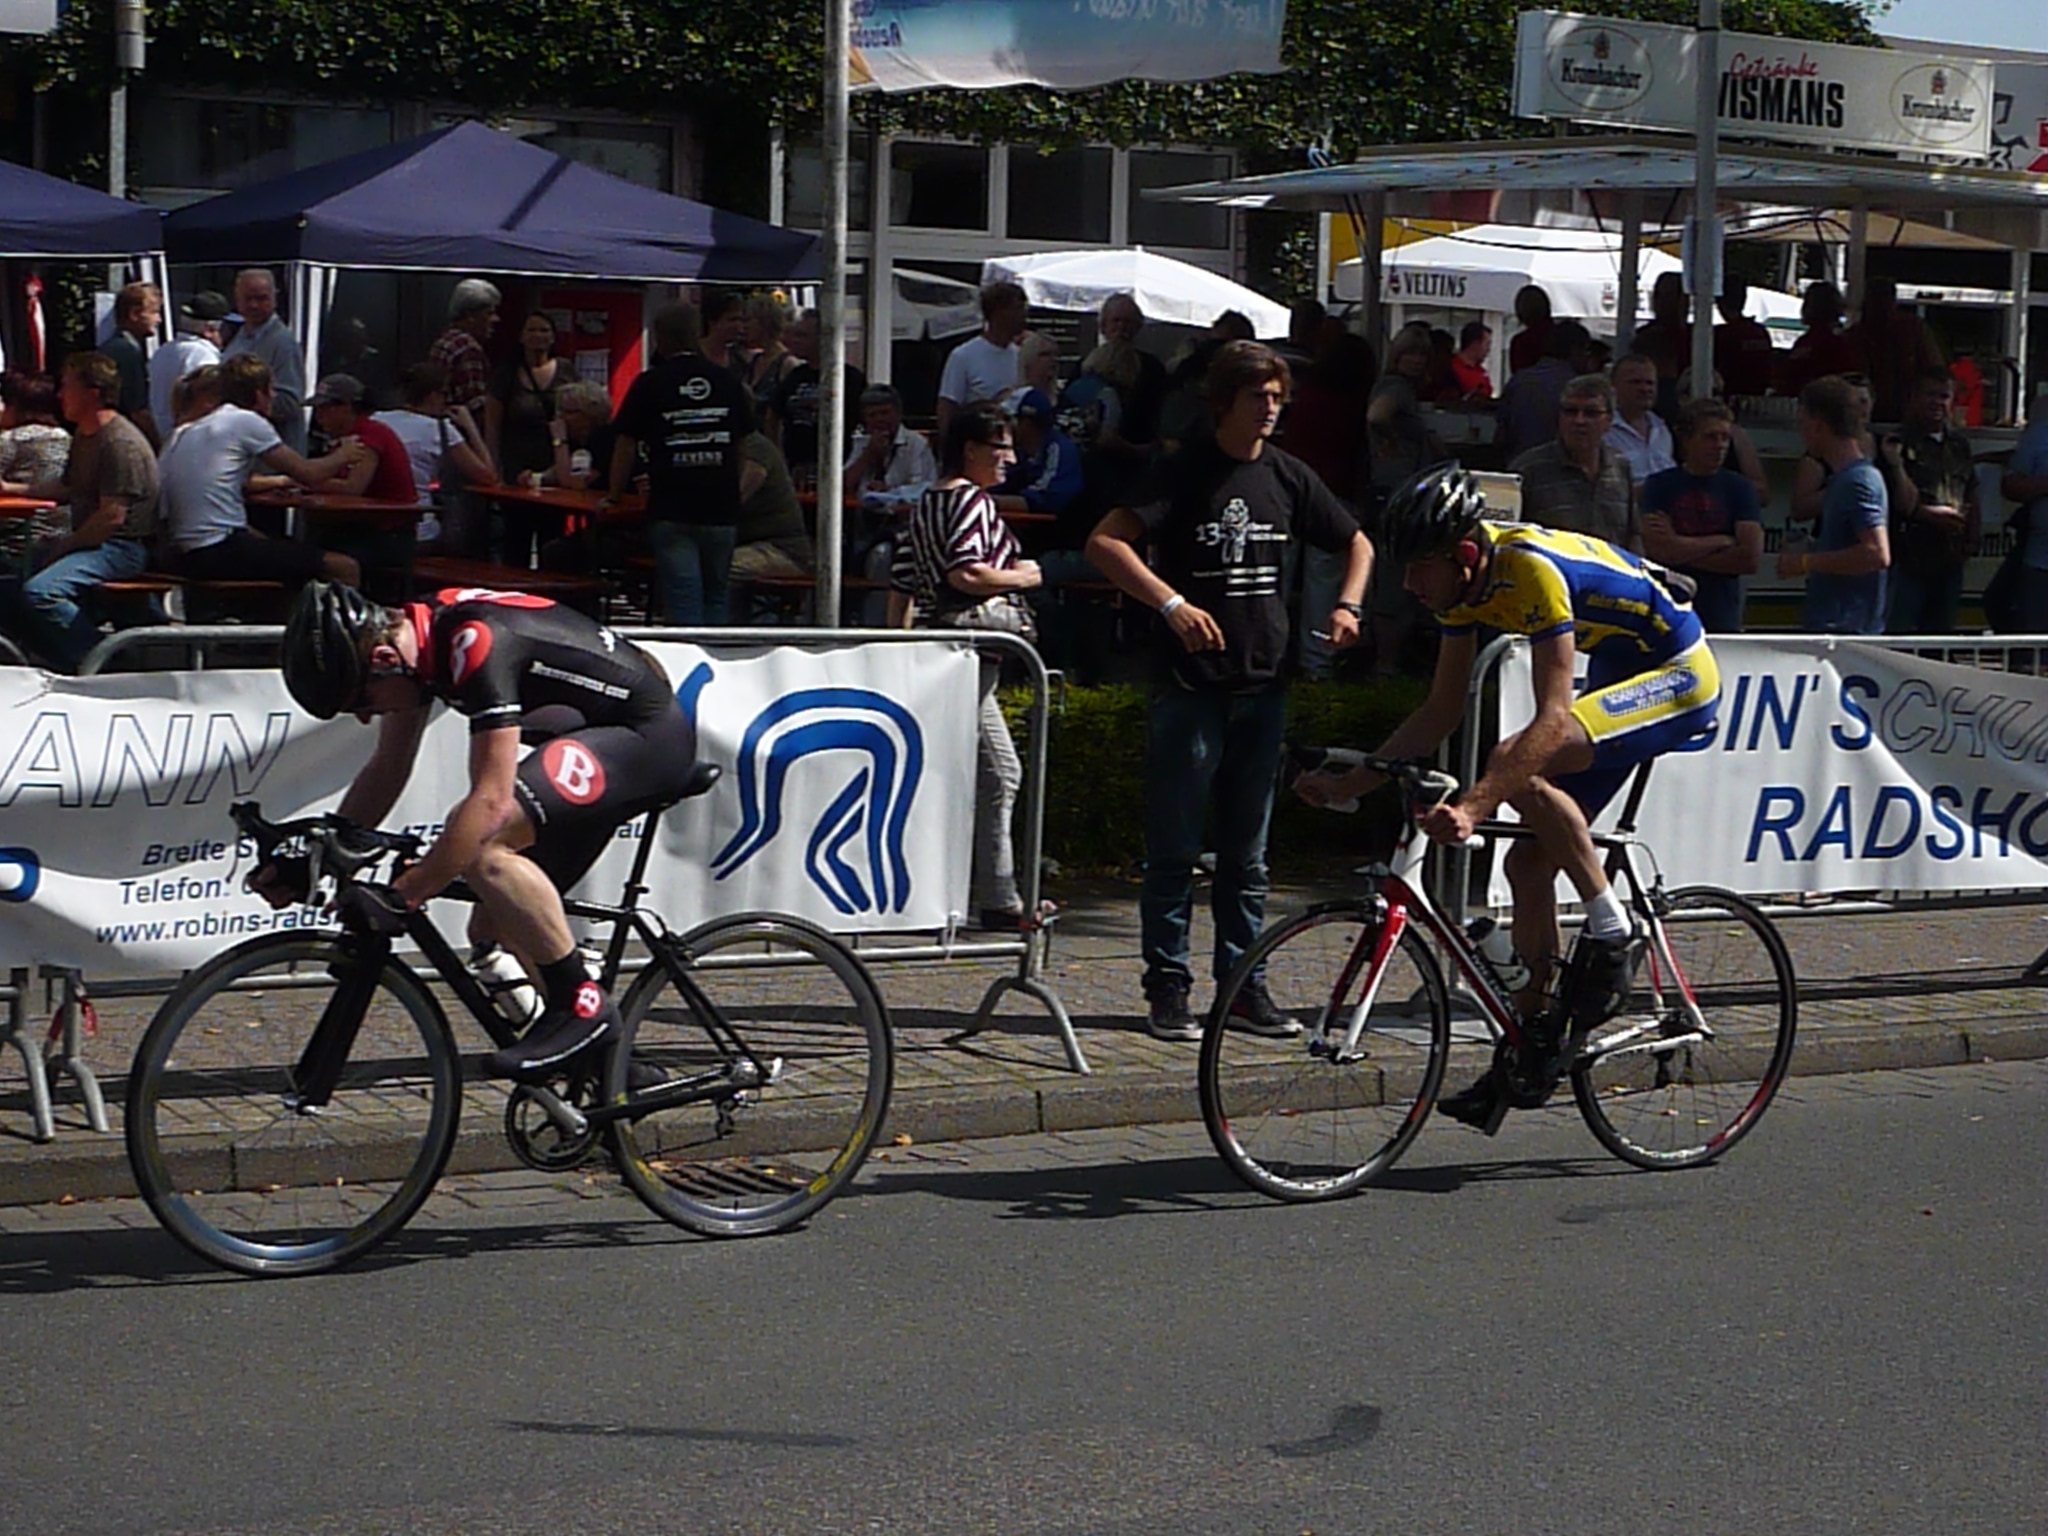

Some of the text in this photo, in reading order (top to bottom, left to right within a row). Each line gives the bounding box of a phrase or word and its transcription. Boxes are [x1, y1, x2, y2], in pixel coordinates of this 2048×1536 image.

[1403, 271, 1467, 298] VELTINS
[555, 745, 595, 796] B
[142, 838, 226, 866] Breite
[96, 905, 338, 944] www.robins-rads
